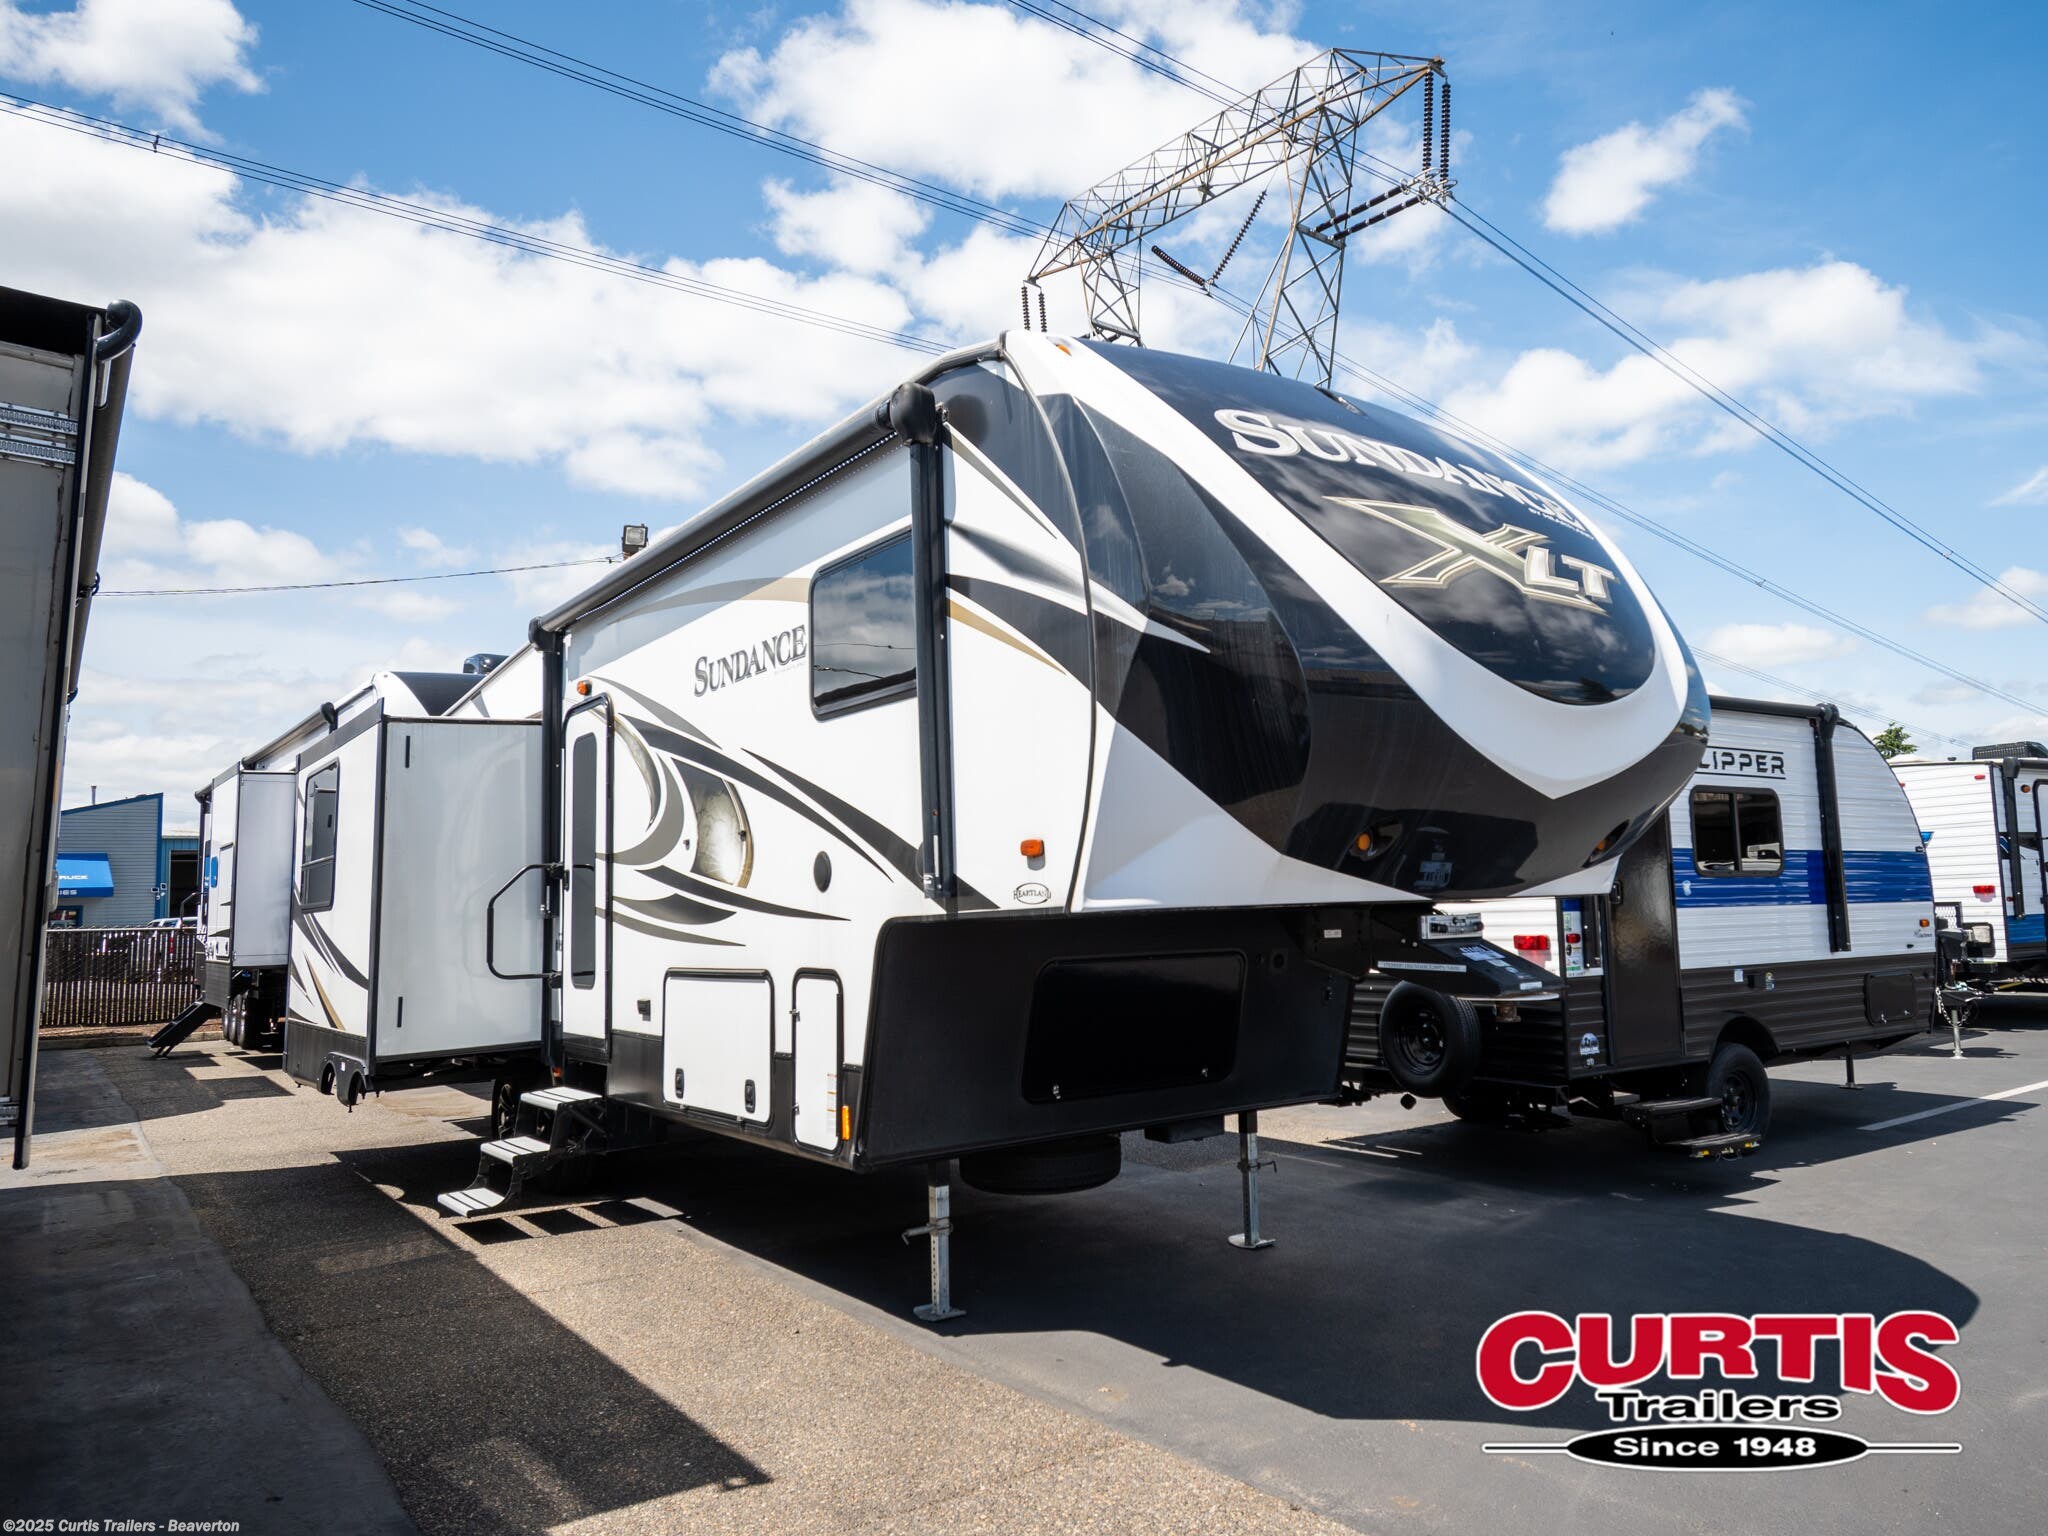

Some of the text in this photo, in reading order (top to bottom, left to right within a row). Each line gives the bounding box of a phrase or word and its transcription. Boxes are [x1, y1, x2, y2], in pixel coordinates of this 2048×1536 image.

[1213, 407, 1587, 532] SUNDANCE
[1323, 496, 1619, 615] XLT
[694, 624, 807, 697] SUNDANCE
